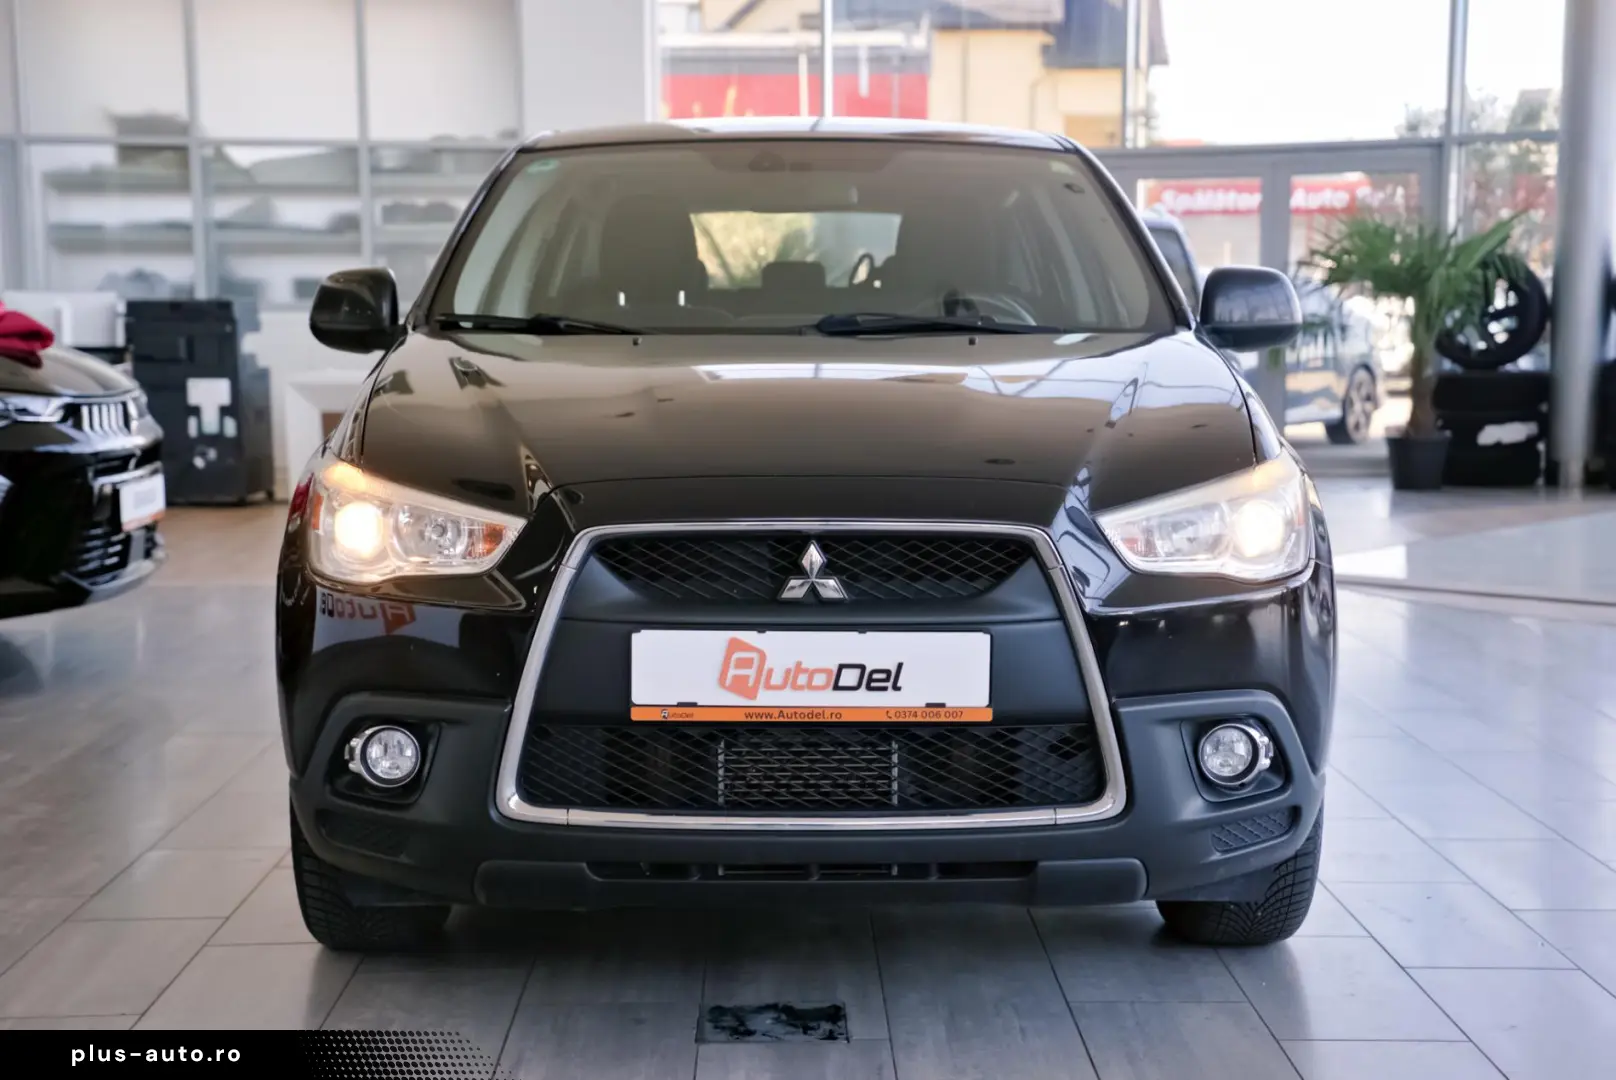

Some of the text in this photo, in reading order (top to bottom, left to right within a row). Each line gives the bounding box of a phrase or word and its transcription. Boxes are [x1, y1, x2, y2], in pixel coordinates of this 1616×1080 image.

[718, 637, 904, 700] AutoDel
[744, 709, 842, 720] www.Autodel.ro
[894, 709, 964, 720] 0374 006 007
